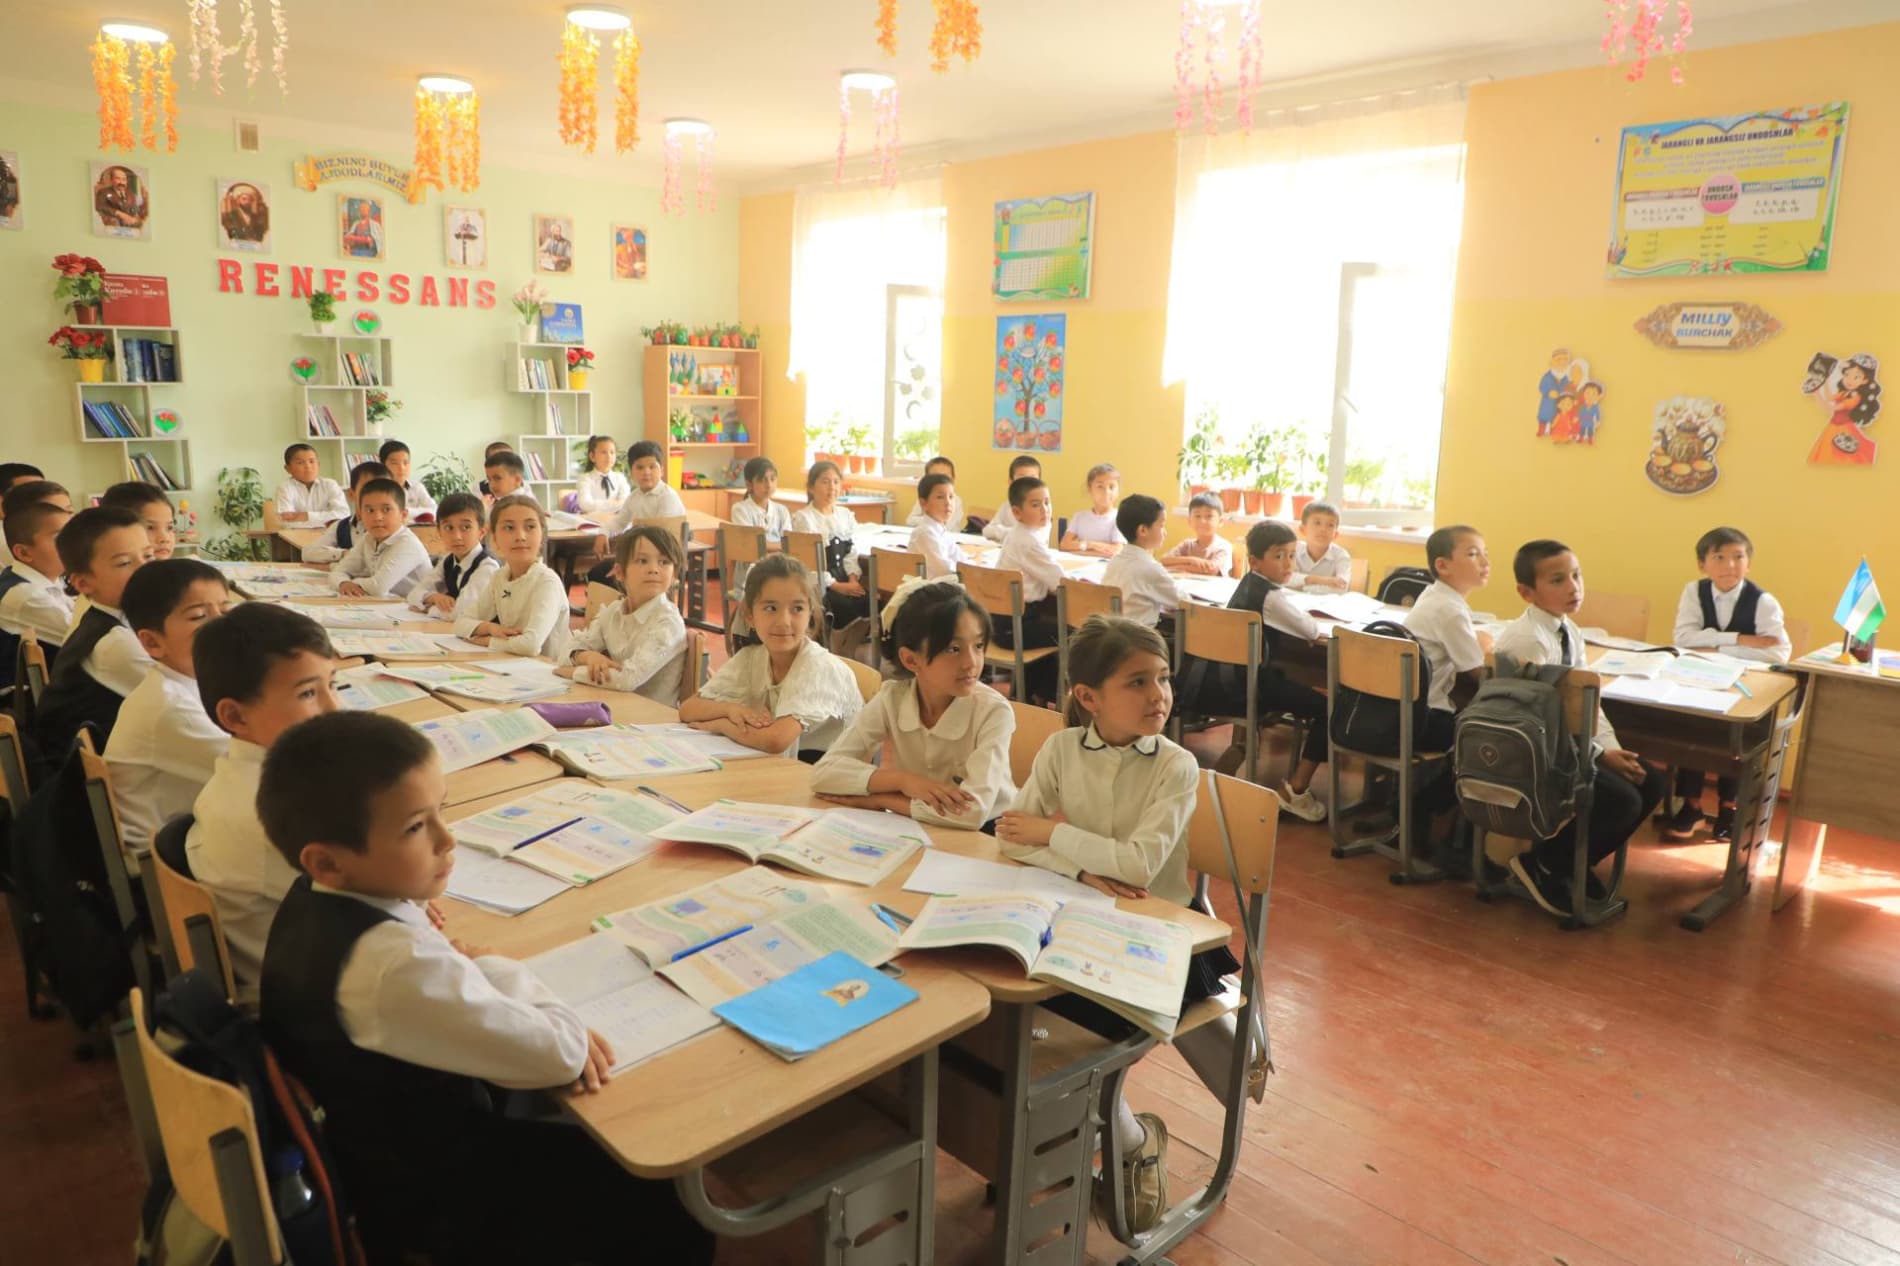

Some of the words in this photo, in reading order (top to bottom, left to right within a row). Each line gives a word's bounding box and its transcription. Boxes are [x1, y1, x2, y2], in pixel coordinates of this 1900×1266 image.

[1747, 128, 1794, 140] UNDOSHLAR
[217, 258, 497, 310] RENESSANS
[1675, 328, 1734, 338] BURCHAK
